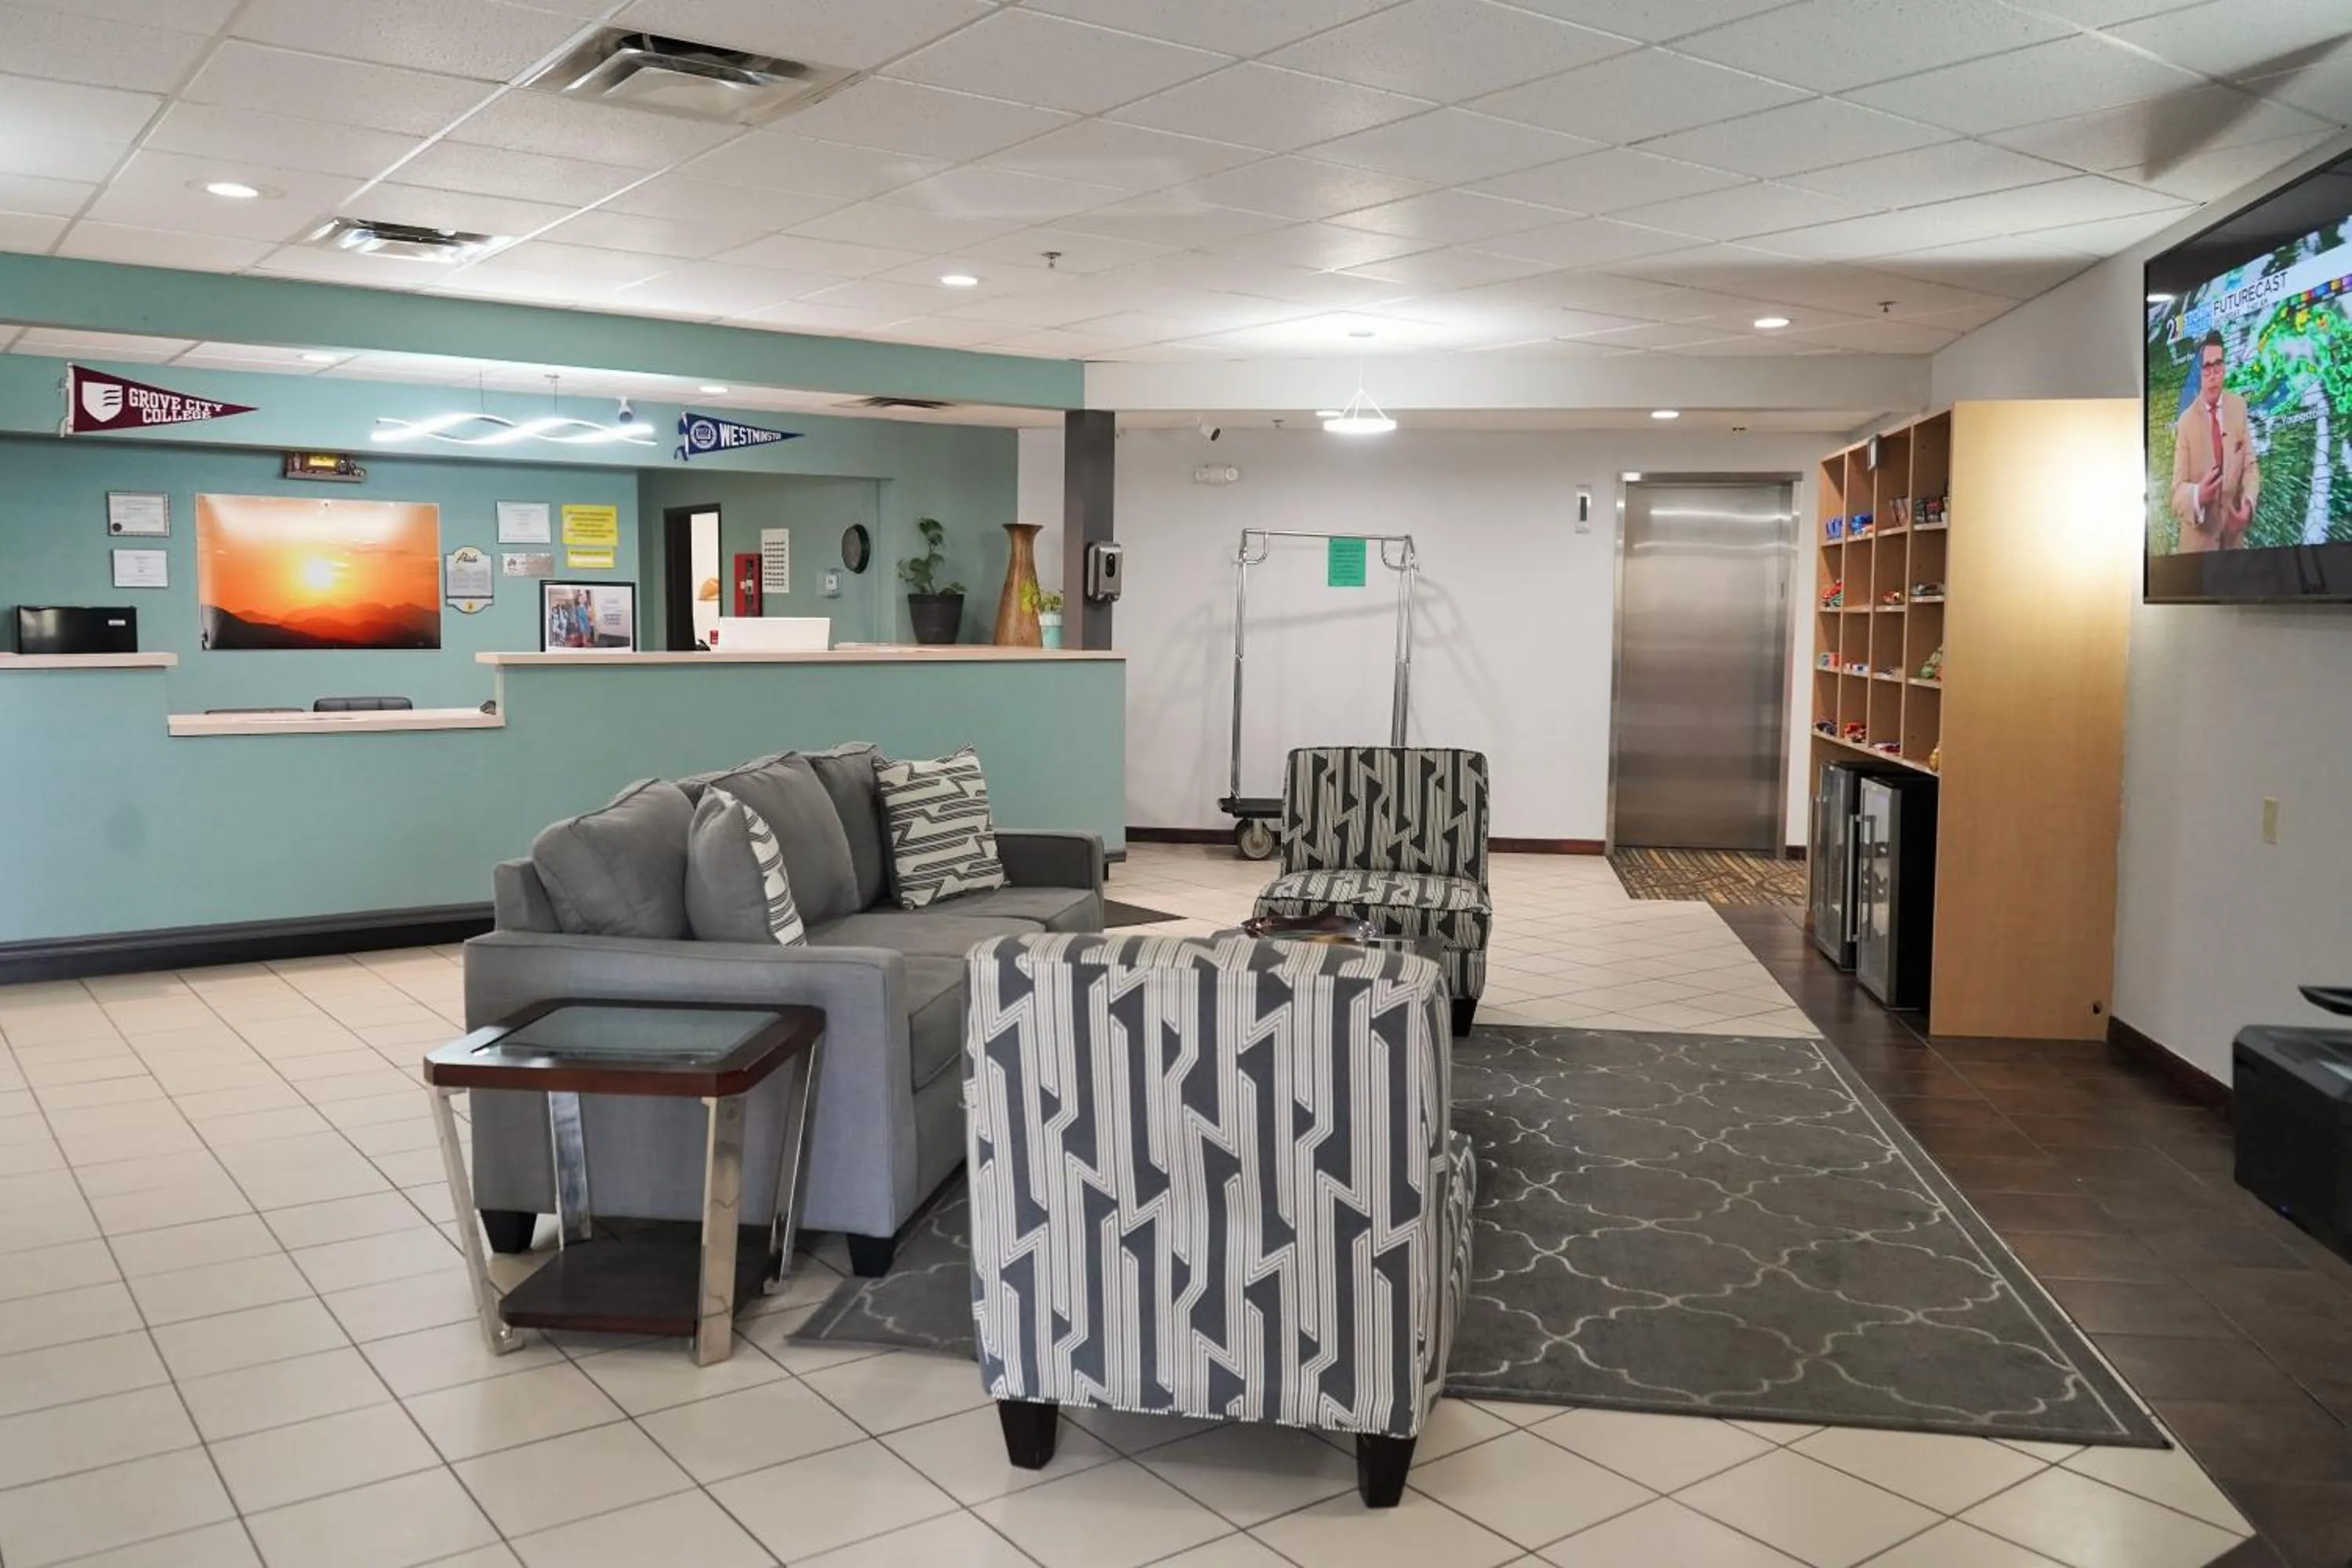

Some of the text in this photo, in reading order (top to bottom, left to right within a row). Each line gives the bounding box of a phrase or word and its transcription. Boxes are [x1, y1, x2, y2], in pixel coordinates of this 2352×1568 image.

[2213, 271, 2288, 315] FUTURECAST
[129, 387, 223, 412] GROVE CITY
[143, 408, 212, 423] COLLEGE
